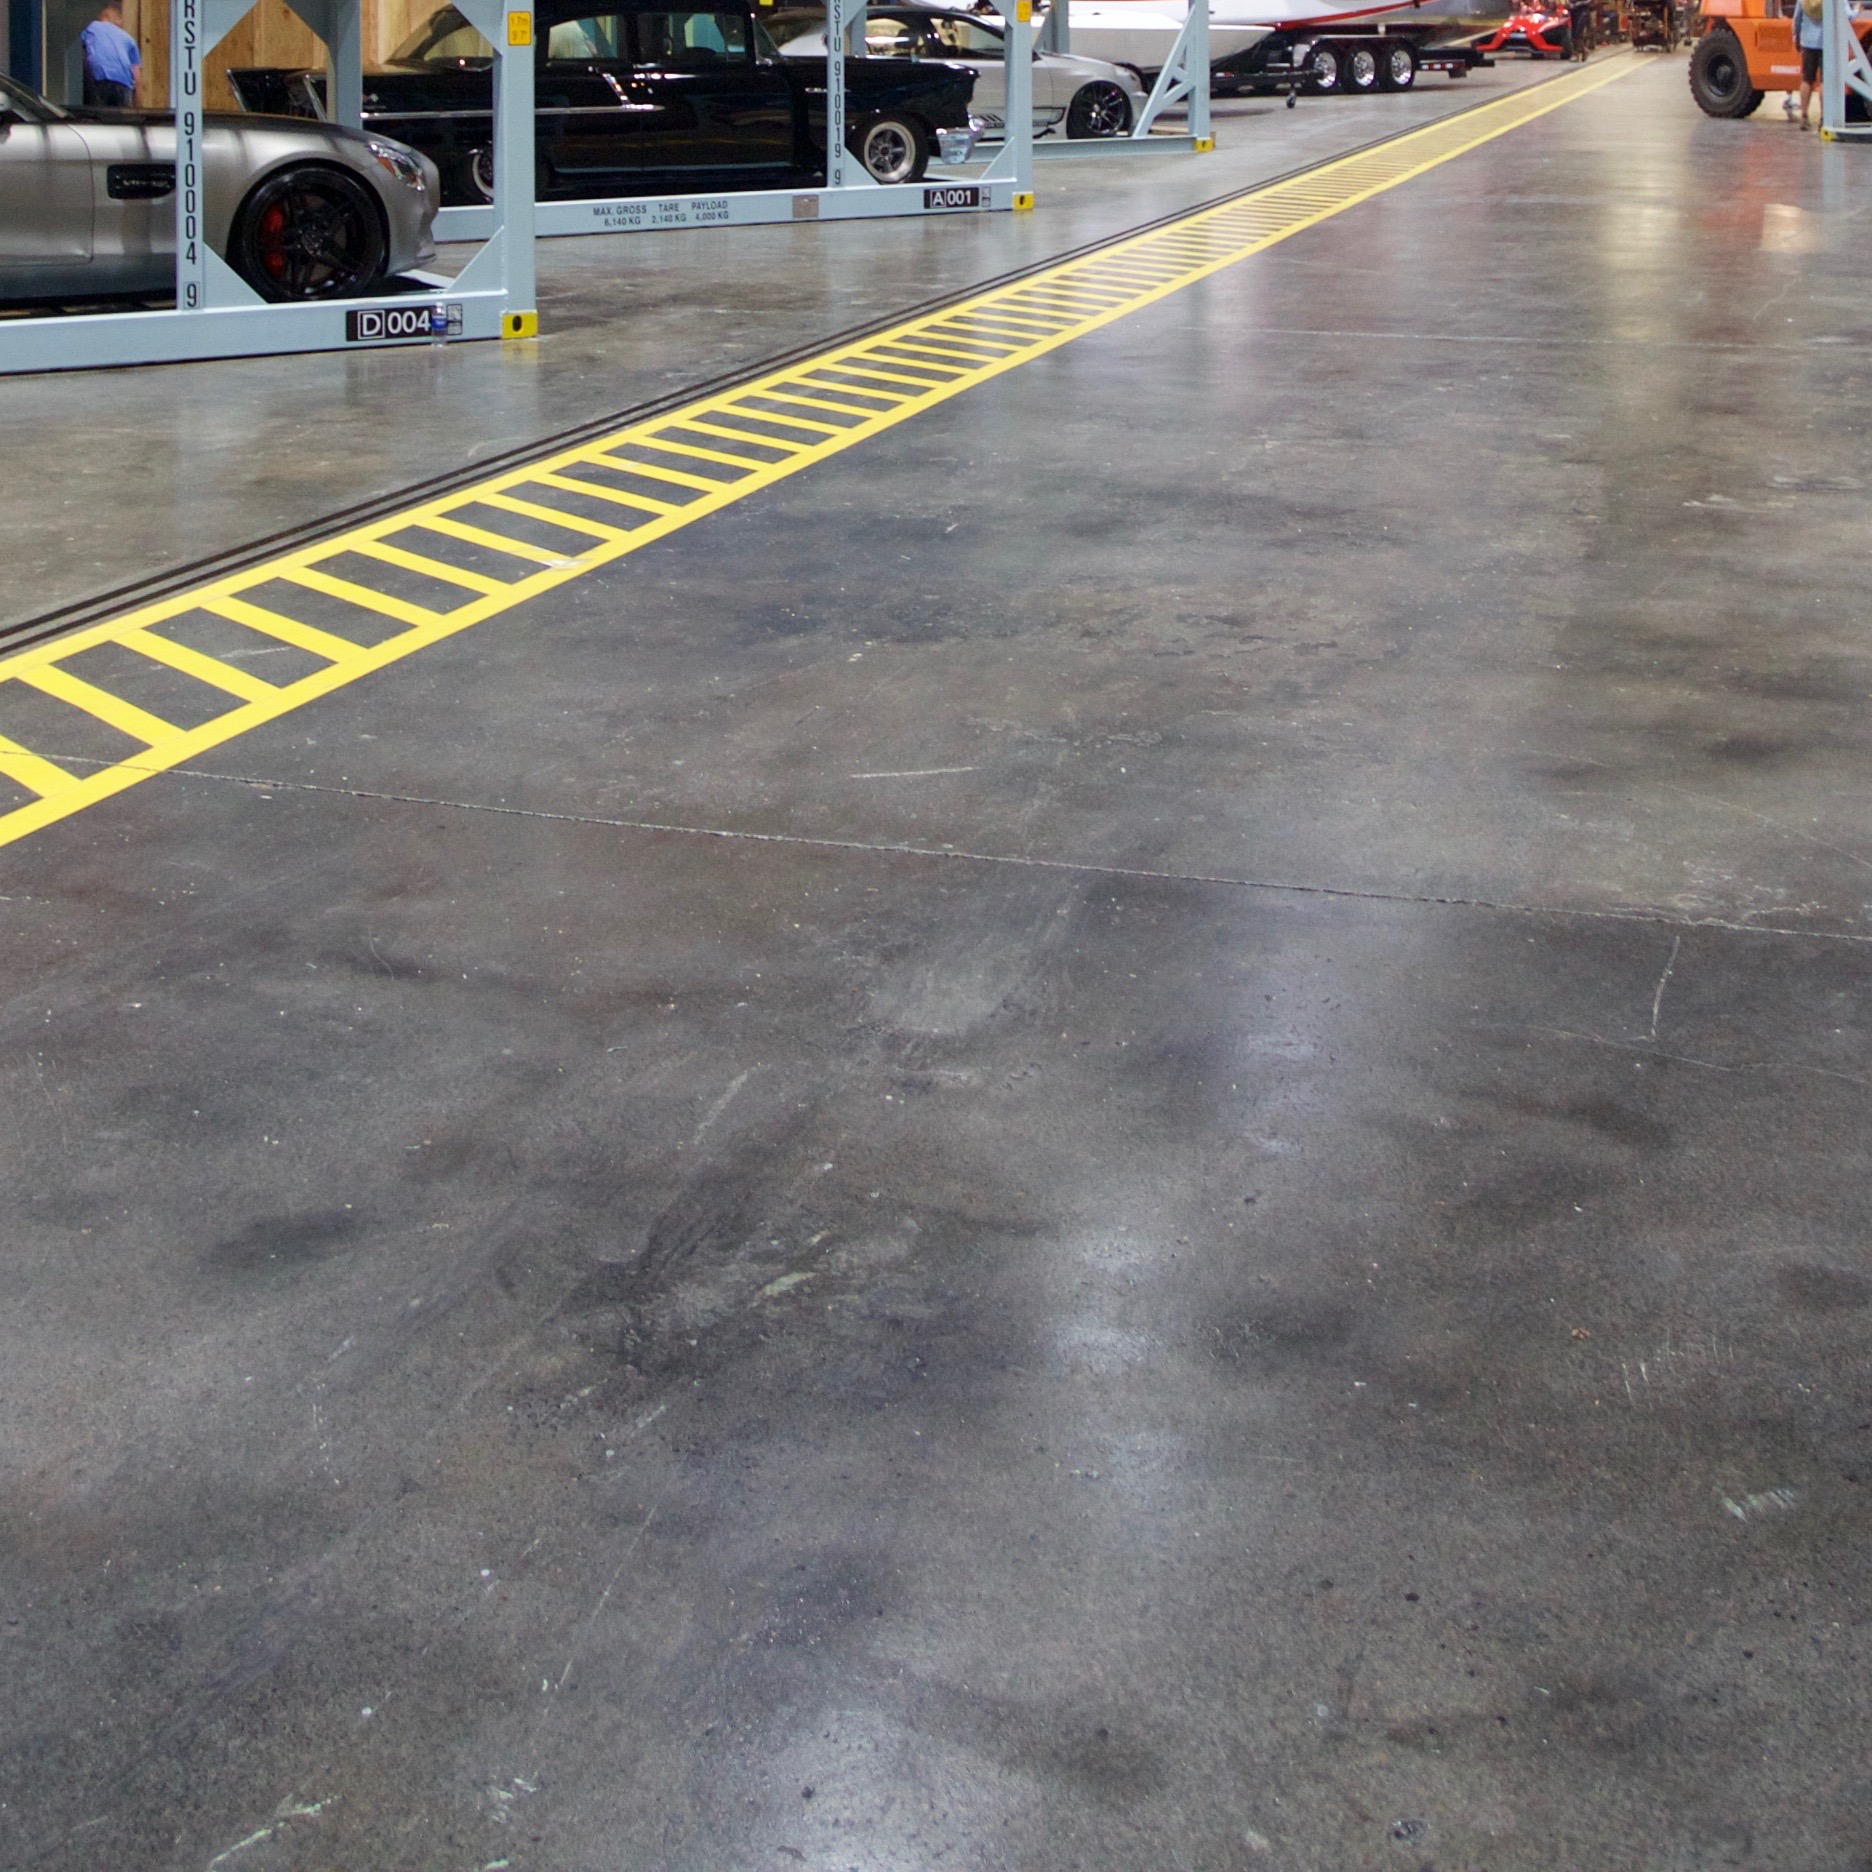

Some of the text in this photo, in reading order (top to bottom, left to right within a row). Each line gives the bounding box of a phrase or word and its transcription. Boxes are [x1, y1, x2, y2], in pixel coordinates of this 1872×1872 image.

[184, 112, 197, 266] 910004
[616, 204, 647, 215] GROSS
[658, 203, 680, 212] TARE
[691, 200, 729, 210] PAYLOAD
[628, 215, 641, 225] KG
[674, 213, 687, 222] KG
[717, 210, 729, 220] KG
